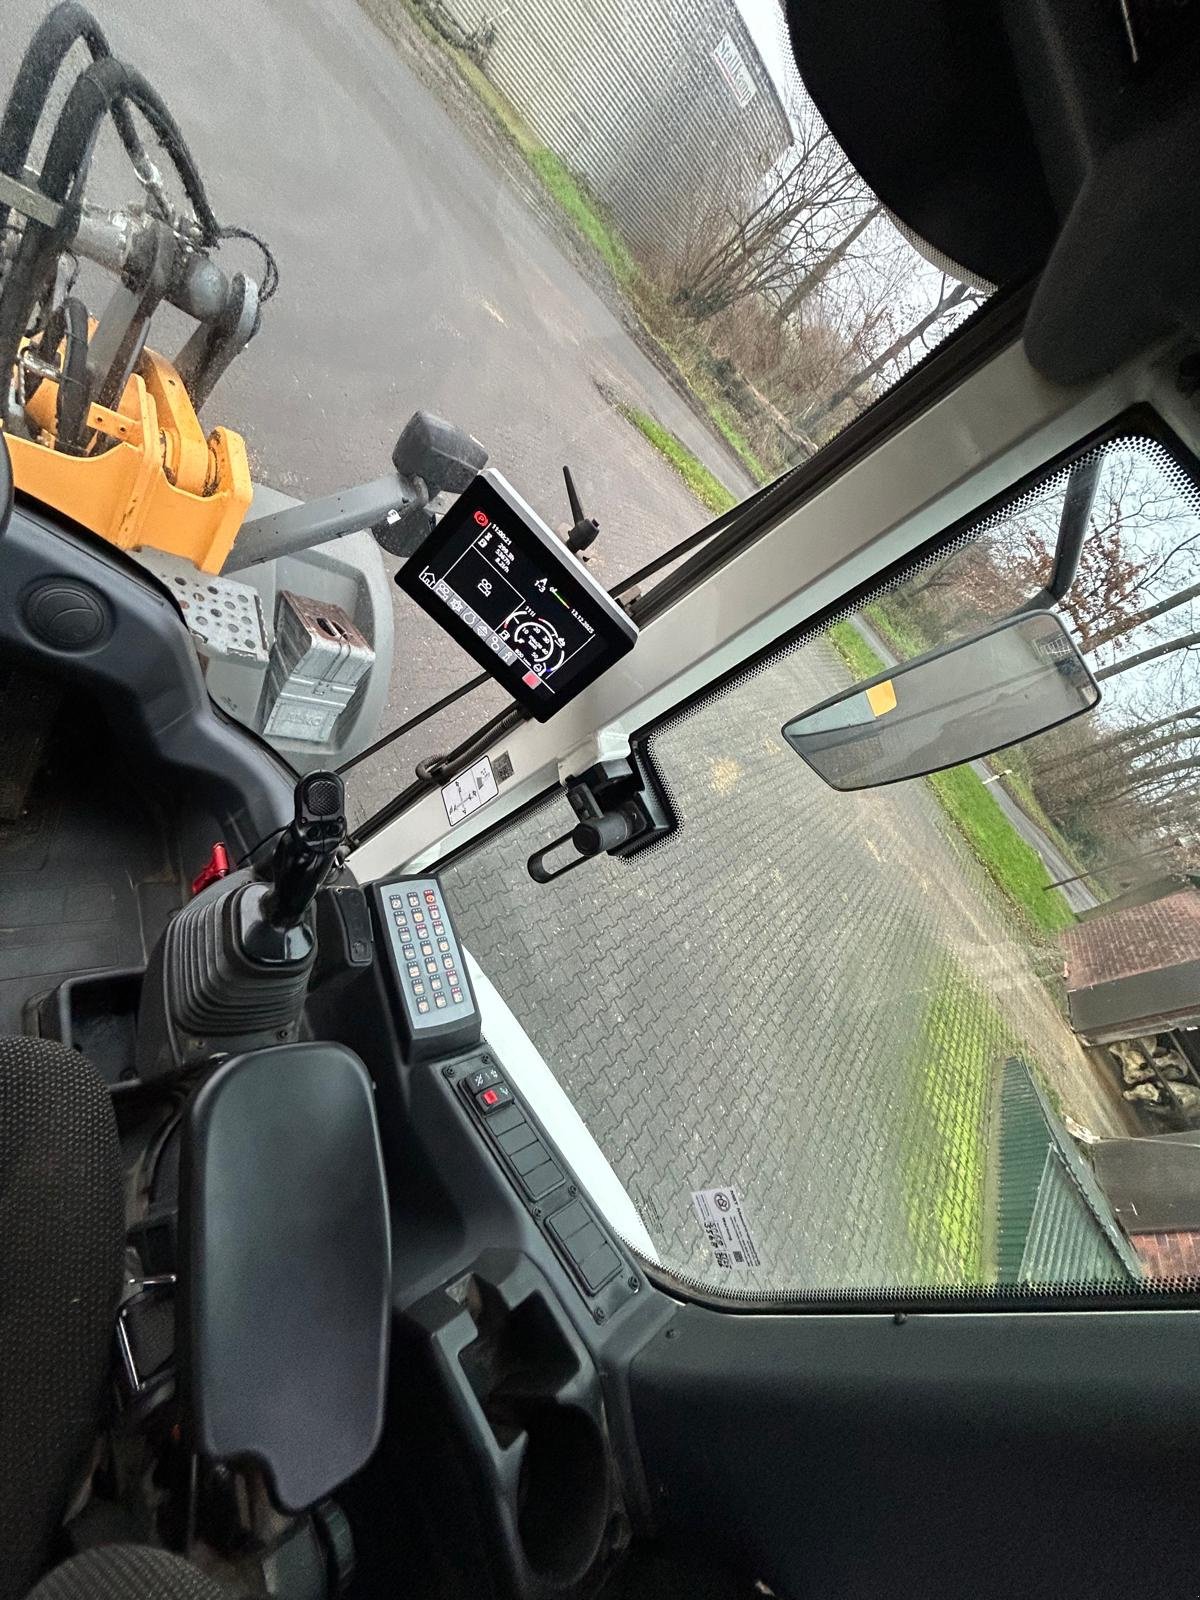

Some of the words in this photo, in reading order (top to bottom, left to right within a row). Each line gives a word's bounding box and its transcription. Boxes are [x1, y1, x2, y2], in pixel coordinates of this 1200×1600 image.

[492, 524, 512, 546] 11:00:21
[534, 580, 546, 593] 1-3
[537, 578, 548, 587] A
[522, 627, 529, 635] 10
[533, 626, 541, 634] 20
[542, 636, 550, 644] 30
